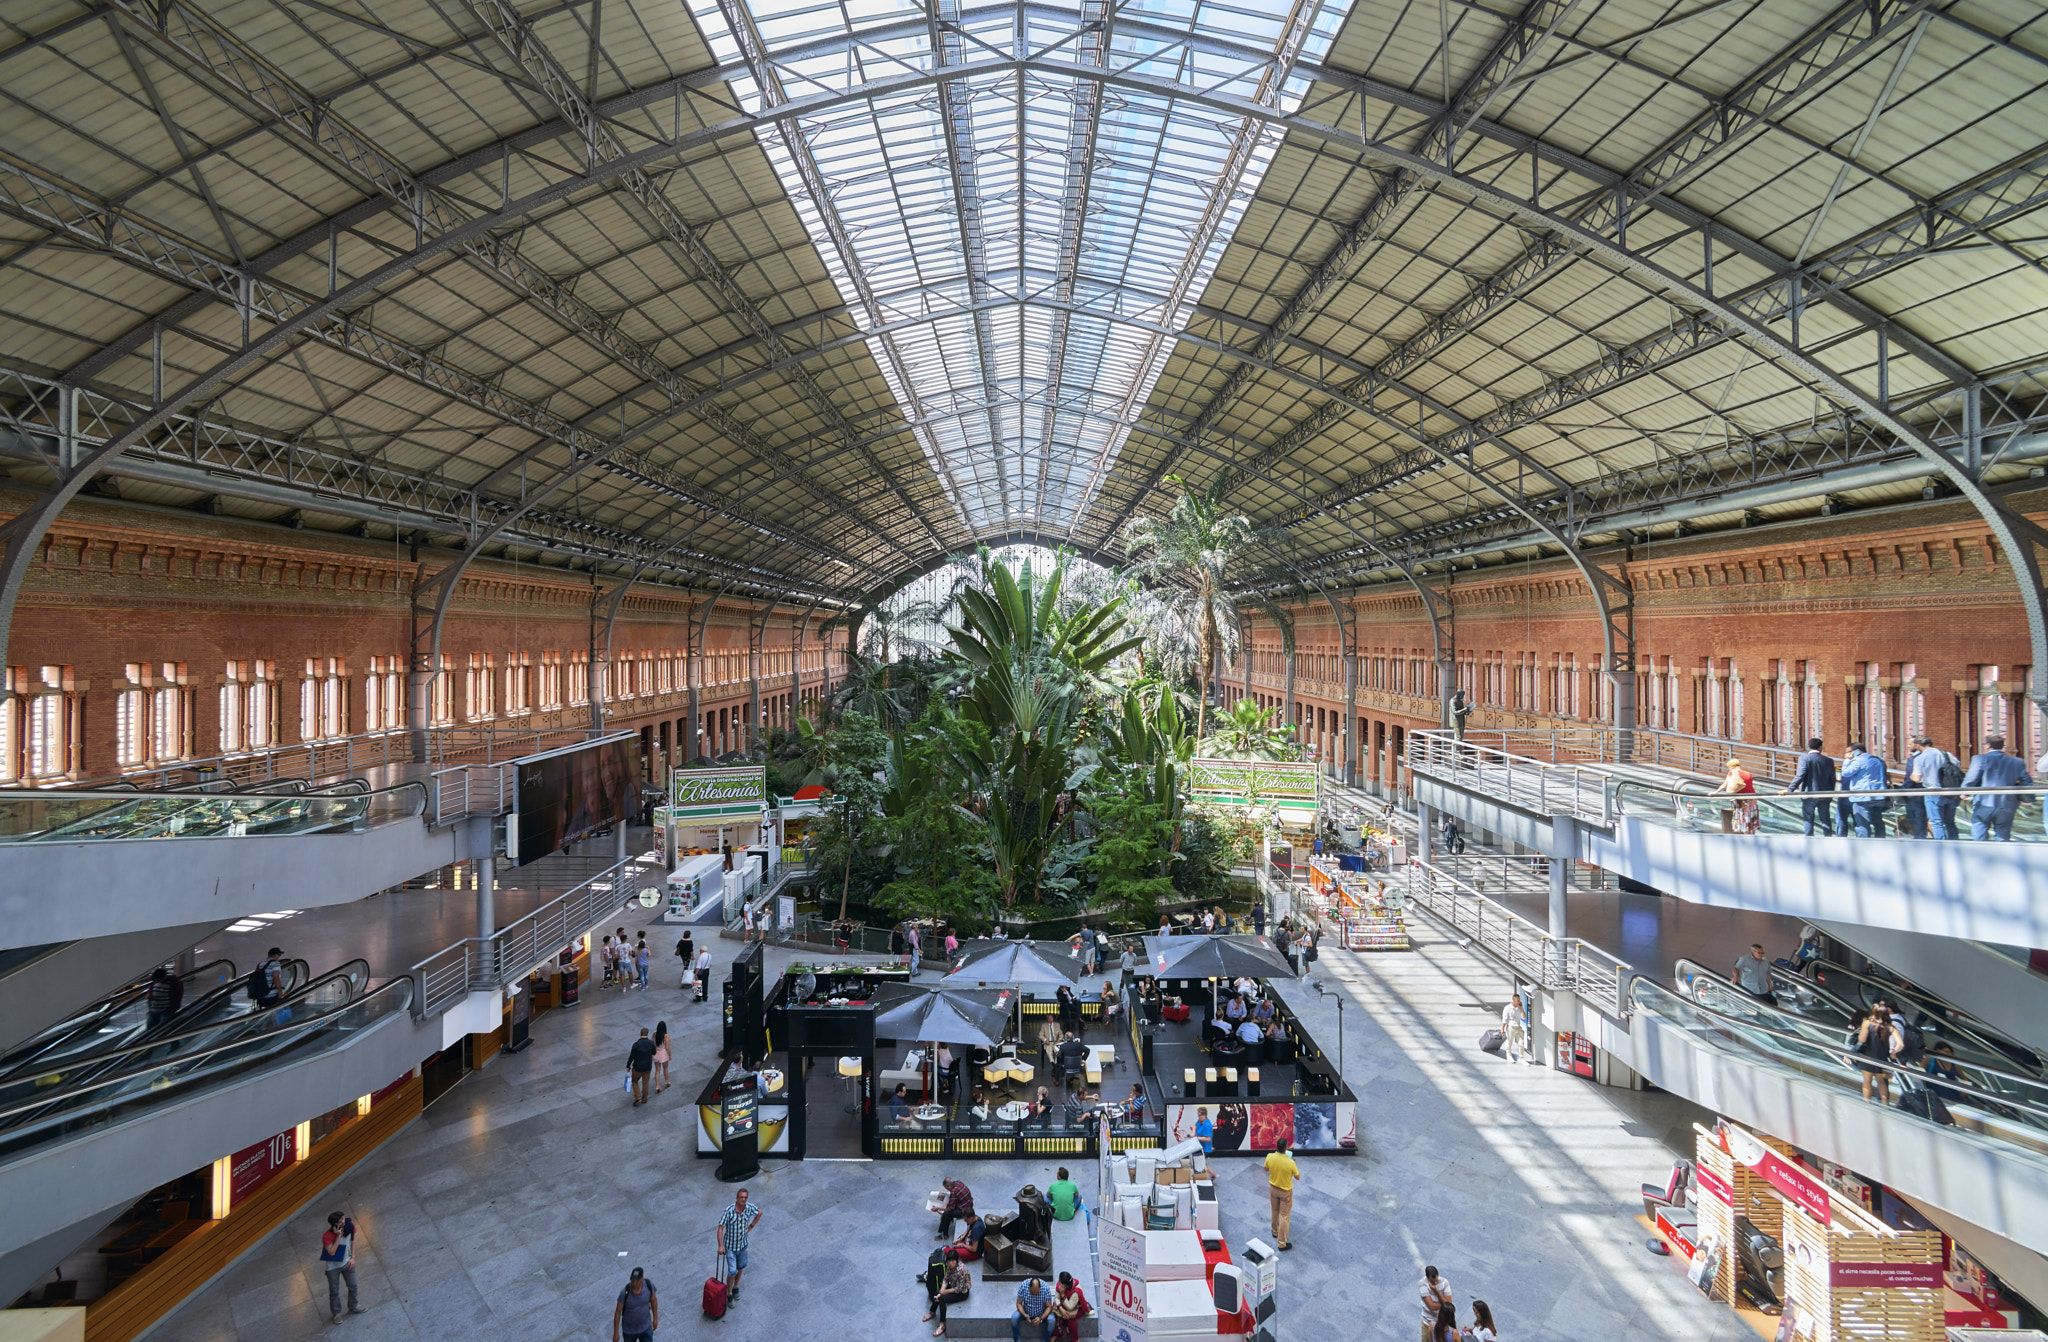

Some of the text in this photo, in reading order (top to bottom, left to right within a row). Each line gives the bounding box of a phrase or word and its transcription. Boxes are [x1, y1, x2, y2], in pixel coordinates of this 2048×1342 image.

[679, 779, 762, 802] Artesanías
[716, 775, 754, 783] Internacional
[268, 1133, 292, 1170] 10€
[1778, 1169, 1825, 1206] relax in style
[1107, 1251, 1132, 1268] COLCHONES
[1109, 1273, 1145, 1315] 70%
[1104, 1299, 1145, 1323] descuento
